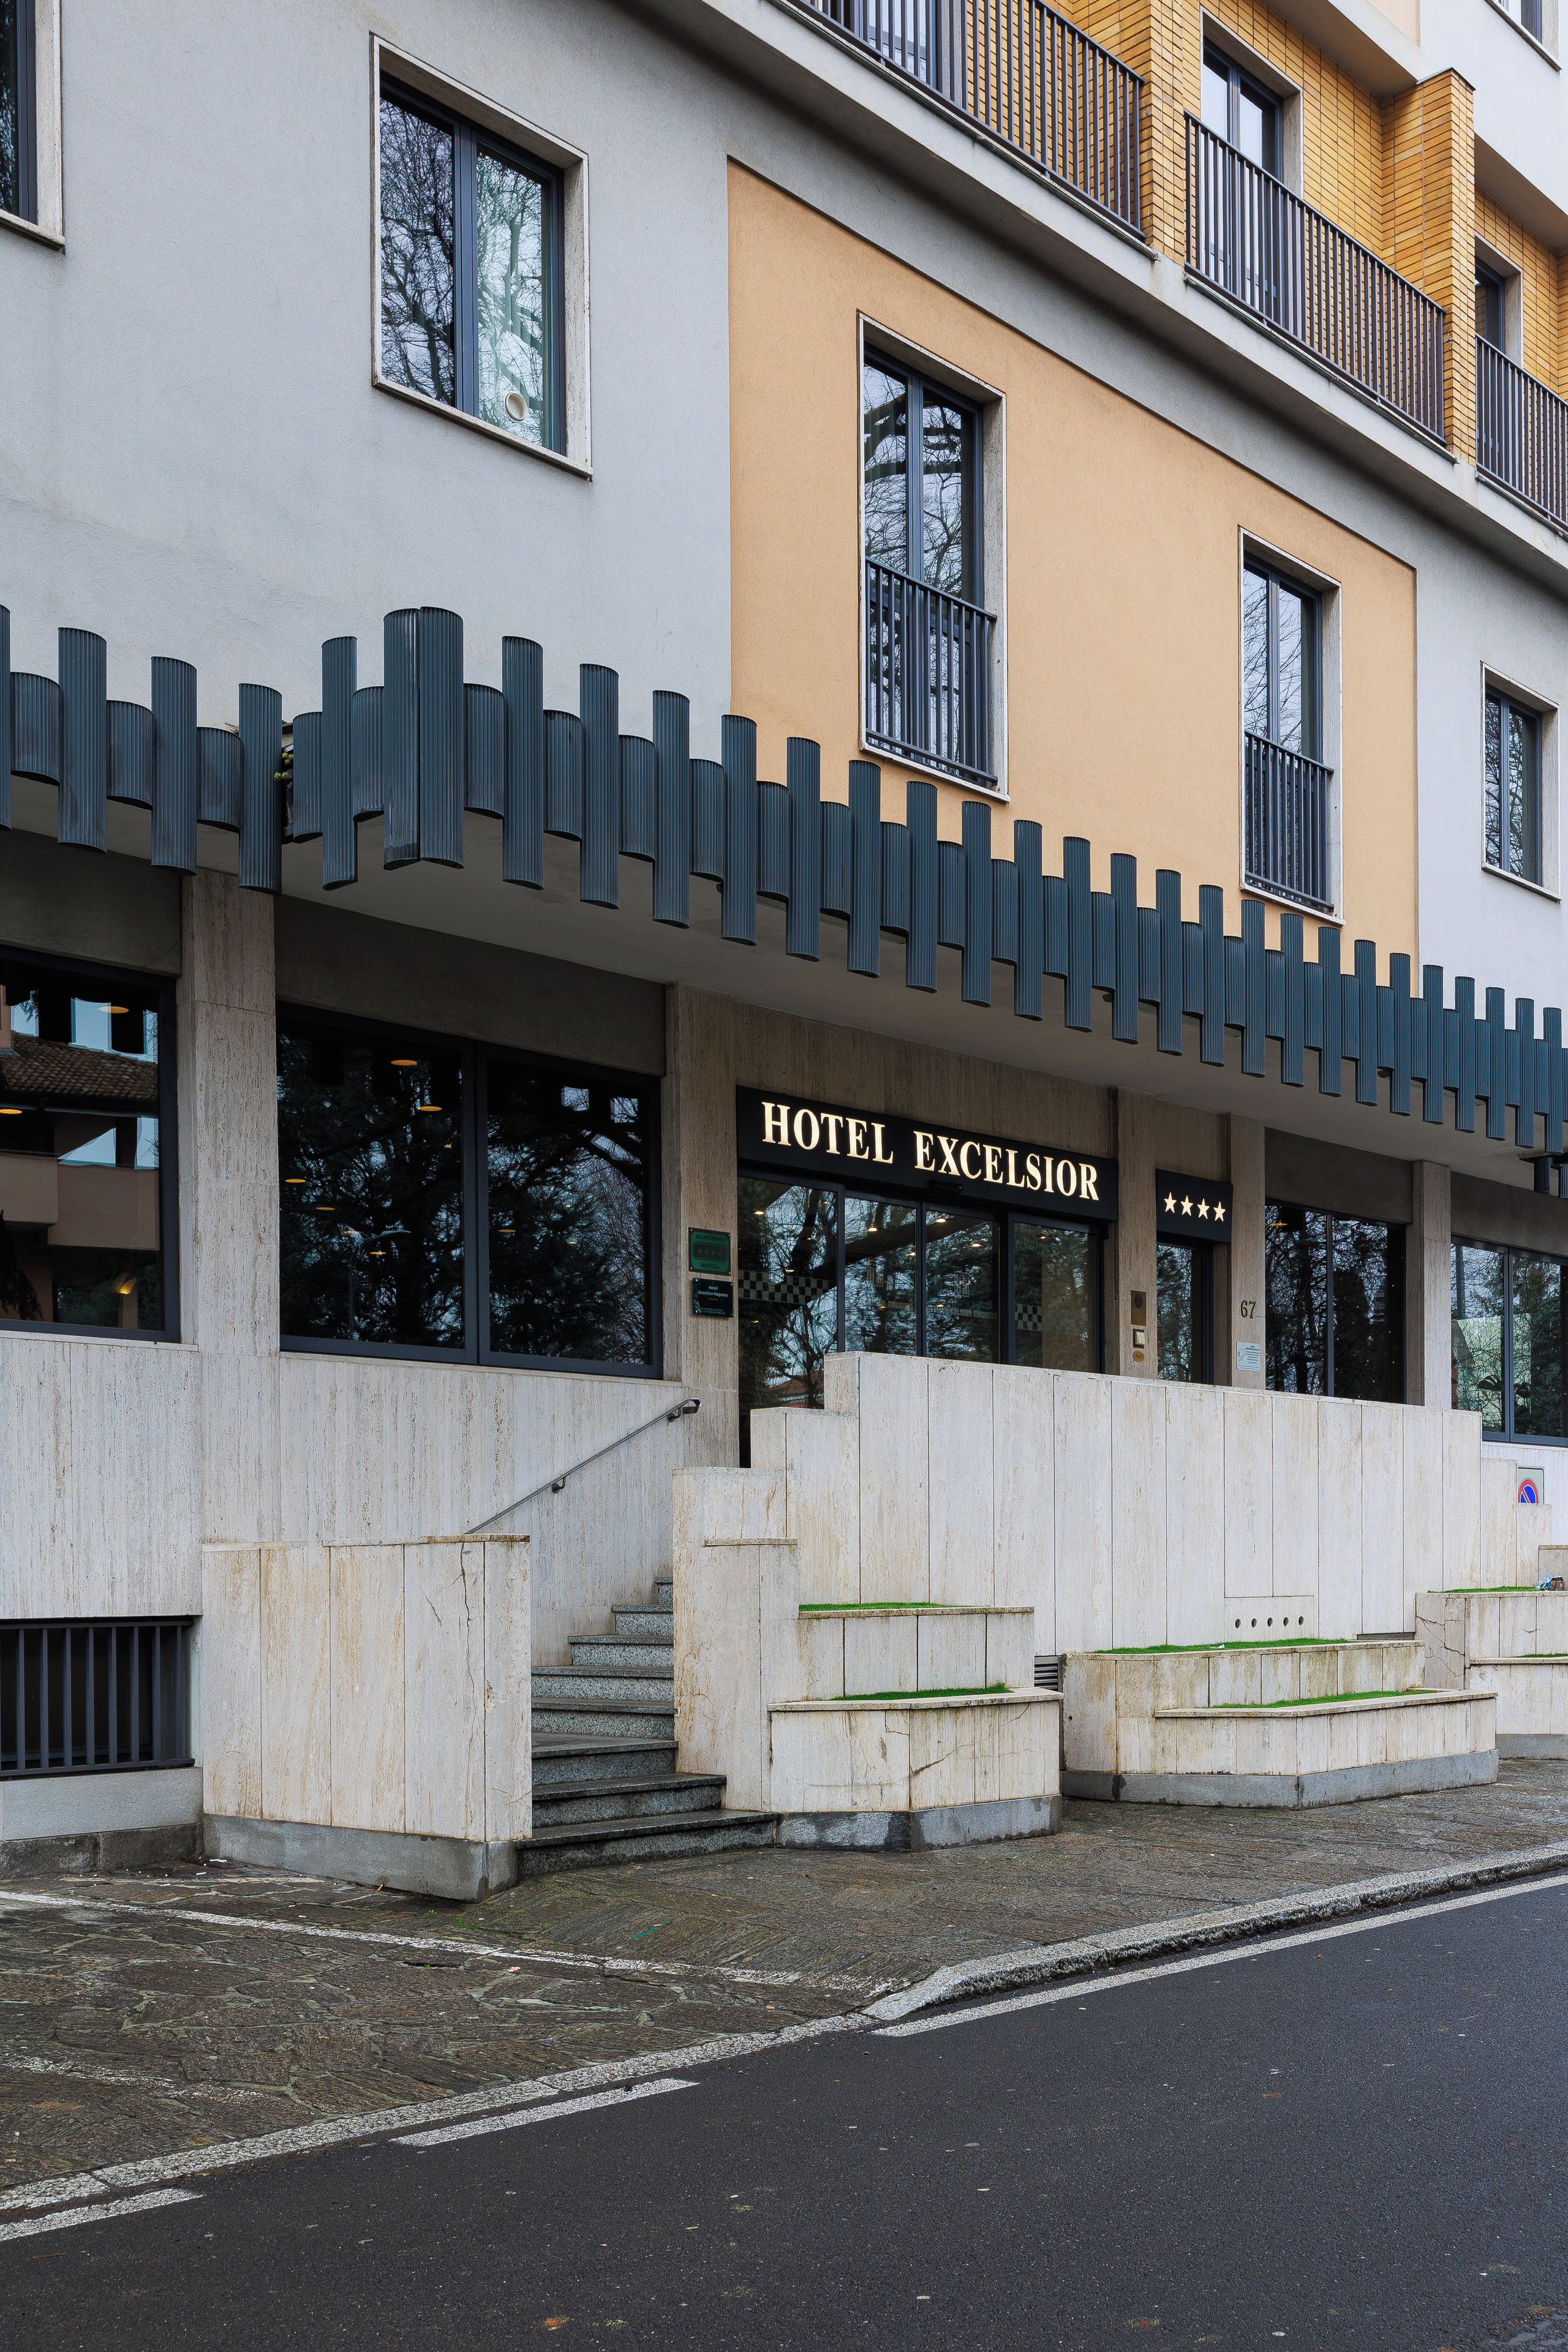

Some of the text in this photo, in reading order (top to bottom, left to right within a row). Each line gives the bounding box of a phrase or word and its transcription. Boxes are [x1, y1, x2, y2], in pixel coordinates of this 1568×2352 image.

[761, 1101, 1099, 1201] HOTEL EXCELSIOR
[1240, 1300, 1256, 1319] 67
